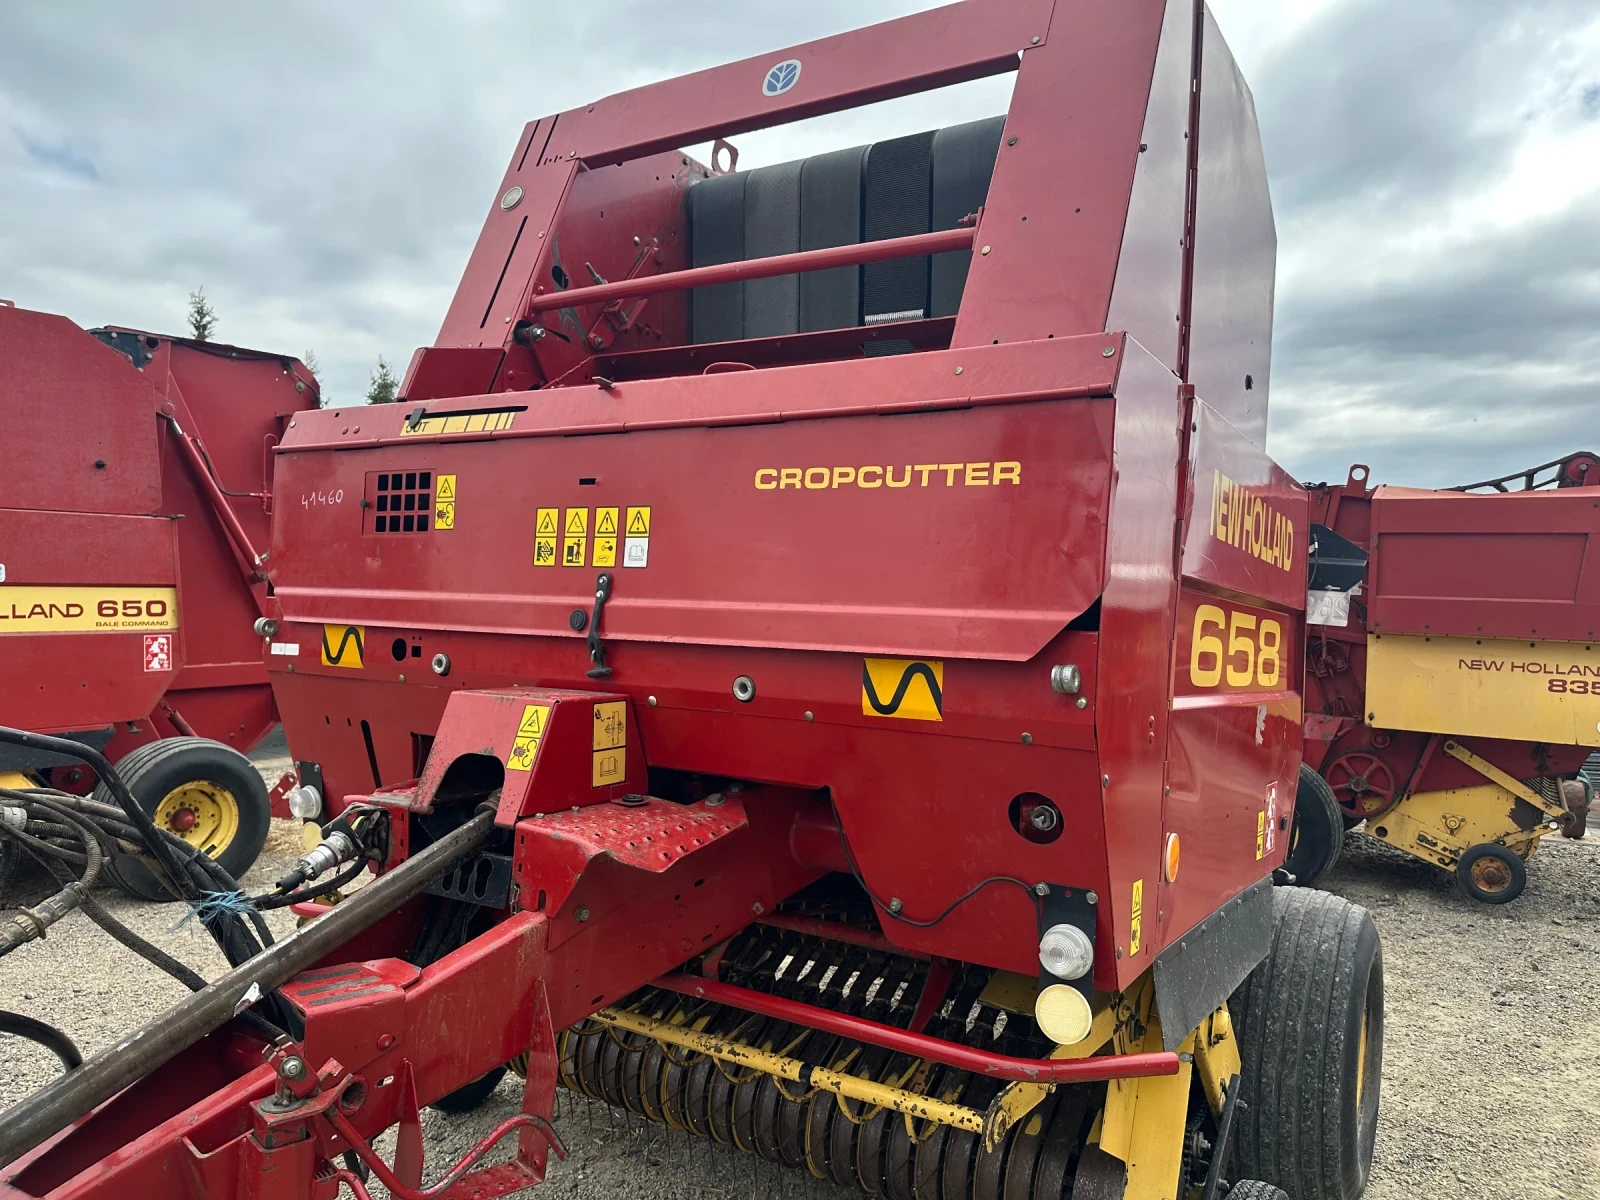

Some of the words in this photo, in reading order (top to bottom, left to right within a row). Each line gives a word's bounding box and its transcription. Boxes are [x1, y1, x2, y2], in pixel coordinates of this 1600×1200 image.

[754, 461, 1021, 489] CROPCUTTER
[301, 488, 344, 510] 41460
[1209, 468, 1244, 548] NEW
[1242, 490, 1294, 572] HOLLAND
[97, 600, 167, 617] 650
[1190, 604, 1281, 688] 658
[1458, 659, 1505, 671] NEW
[1511, 661, 1600, 677] HOLLAN
